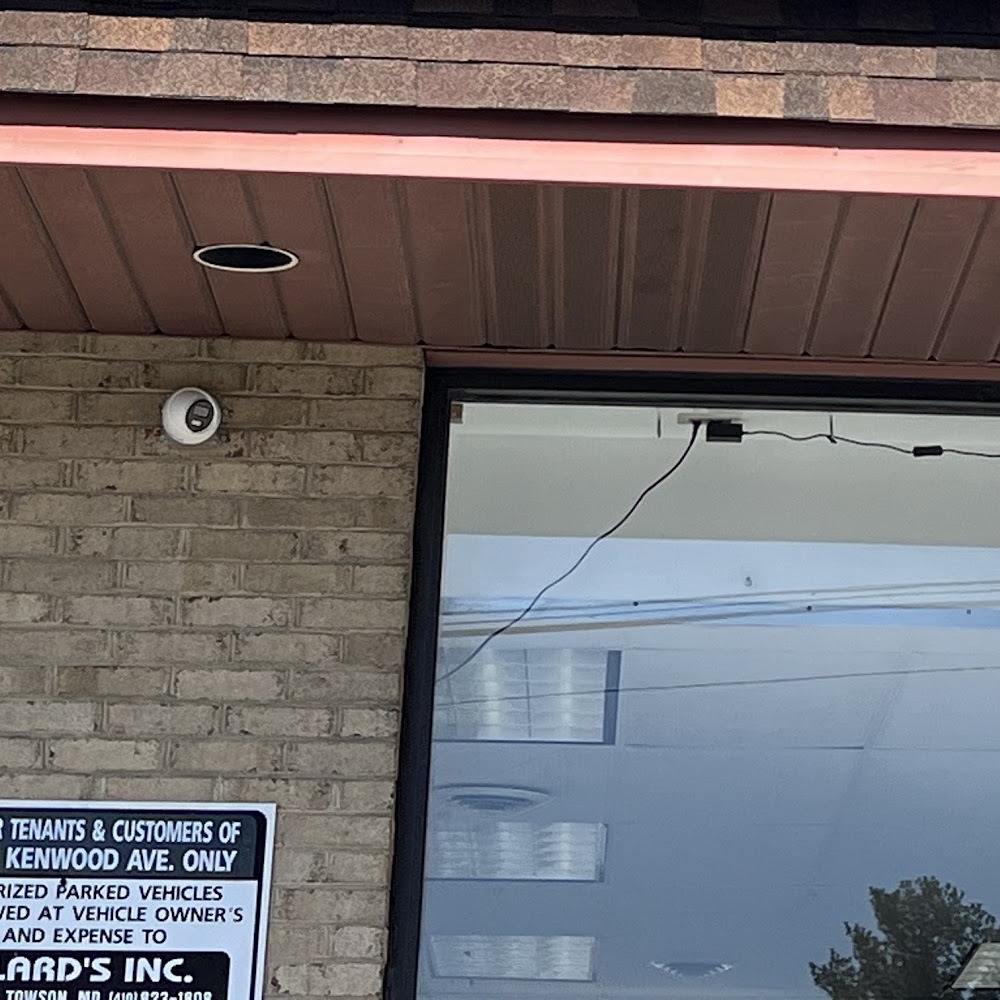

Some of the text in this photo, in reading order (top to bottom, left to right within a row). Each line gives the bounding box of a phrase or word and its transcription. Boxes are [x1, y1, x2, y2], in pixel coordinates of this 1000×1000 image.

[10, 817, 87, 841] TENANTS
[91, 819, 106, 842] &
[112, 819, 214, 843] CUSTOMERS
[218, 821, 242, 844] OF
[5, 846, 238, 872] KENWOOD AVE. ONLY
[56, 884, 130, 900] PARKED
[139, 885, 223, 901] VEHICLES
[37, 905, 65, 921] AT
[73, 905, 147, 922] VEHICLE
[155, 906, 243, 922] OWNER'S
[2, 927, 167, 944] AND EXPENSE TO
[124, 957, 194, 984] INC.
